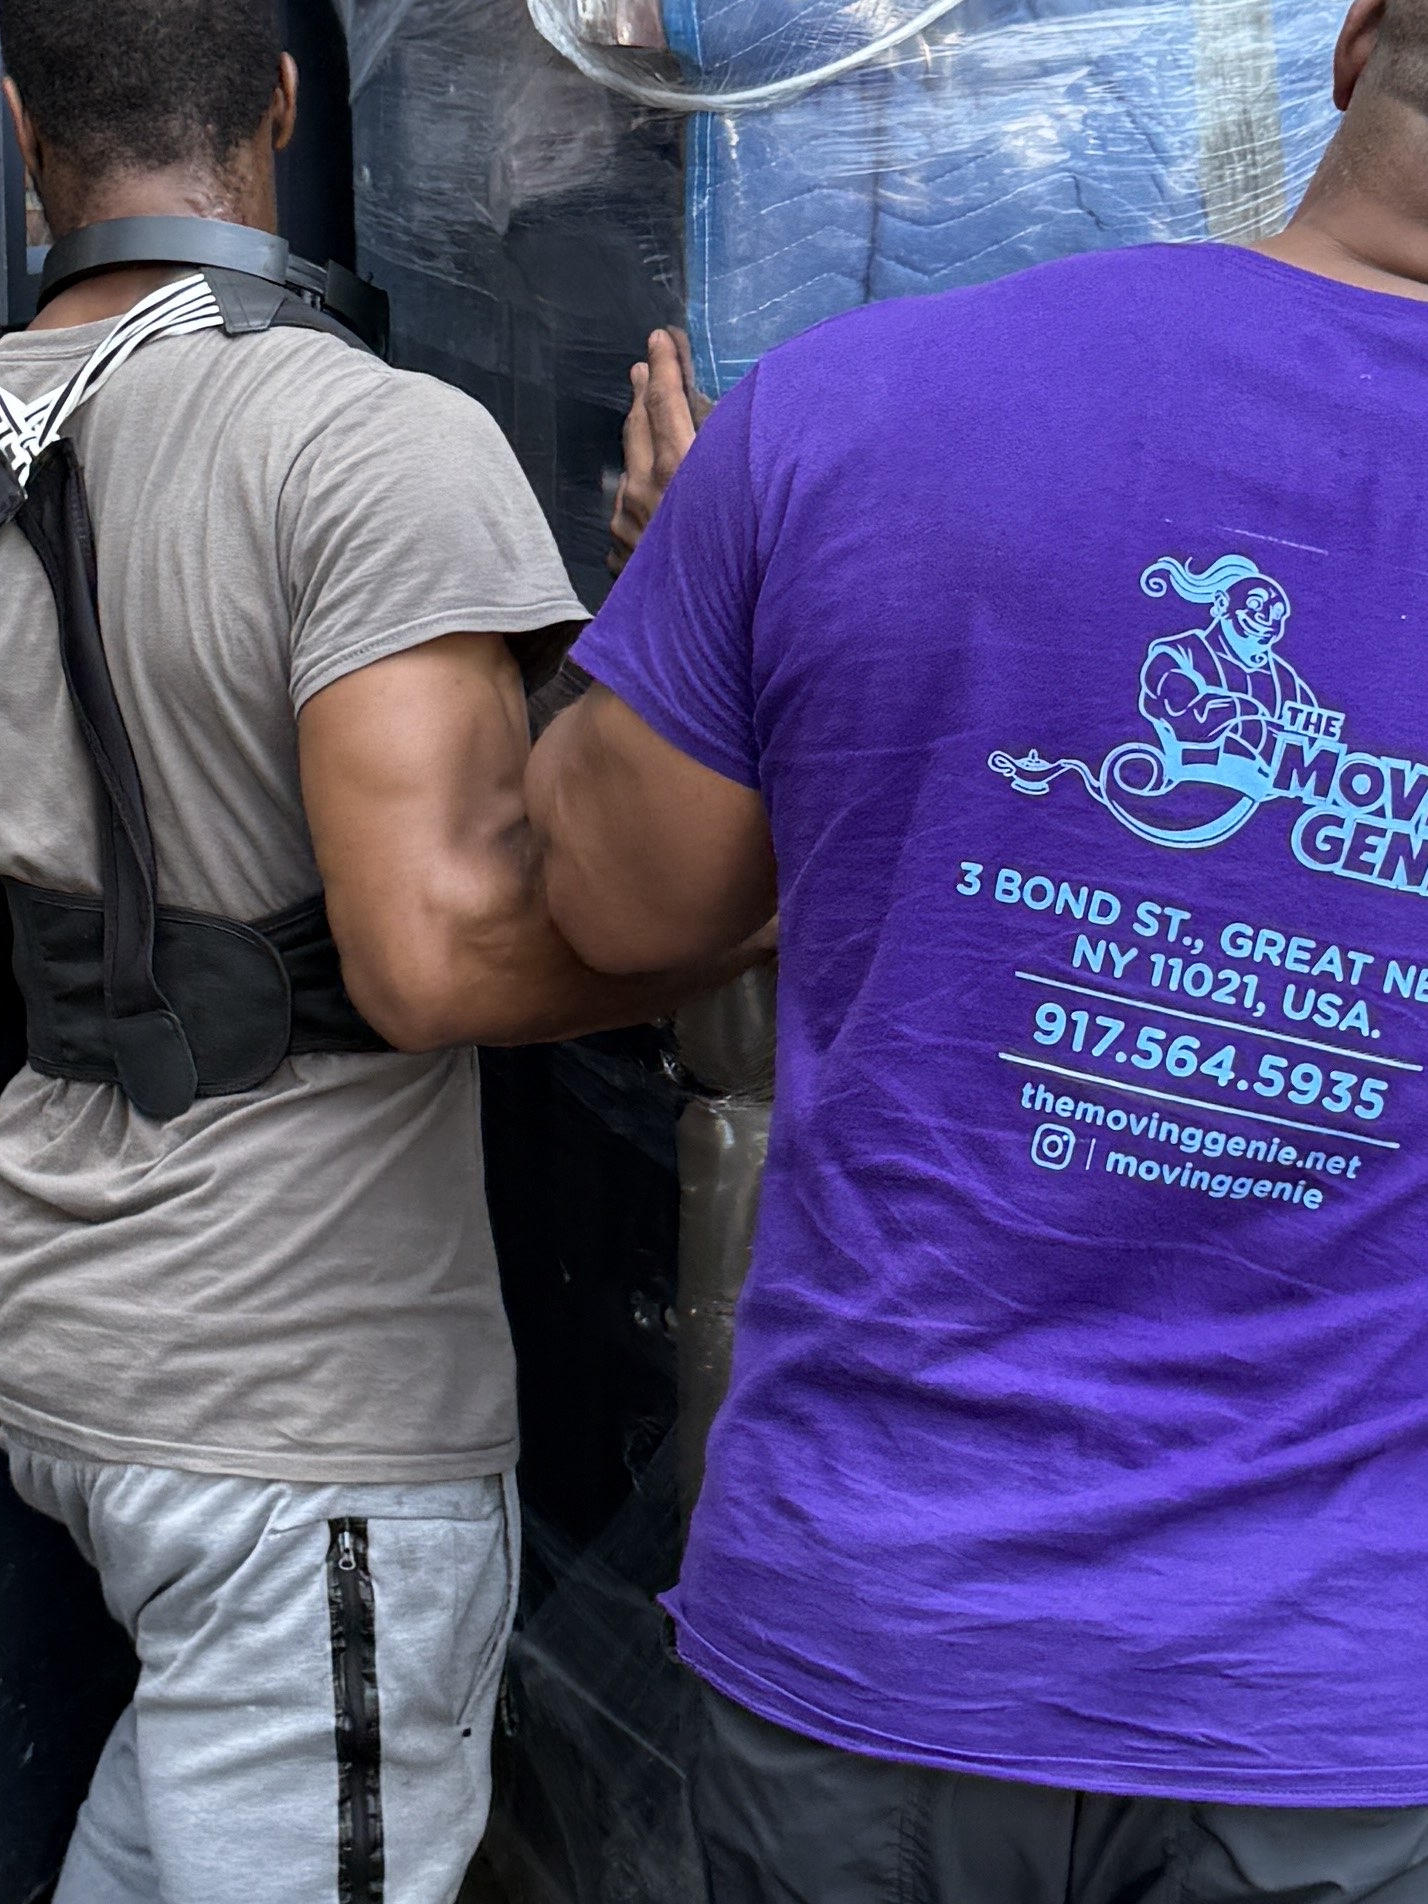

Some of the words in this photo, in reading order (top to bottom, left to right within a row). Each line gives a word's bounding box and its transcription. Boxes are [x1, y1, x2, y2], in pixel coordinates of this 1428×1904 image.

[1282, 702, 1345, 741] THE
[956, 862, 982, 895] 3
[995, 867, 1121, 926] BOND
[1132, 901, 1204, 955] ST.,
[1220, 923, 1375, 984] GREAT
[1072, 935, 1138, 979] NY
[1148, 952, 1266, 1019] 11021,
[1282, 984, 1381, 1039] USA.
[1034, 1003, 1389, 1119] 917.564.5935
[1020, 1082, 1362, 1179] themovinggenie.net
[1106, 1150, 1324, 1210] movinggenie
